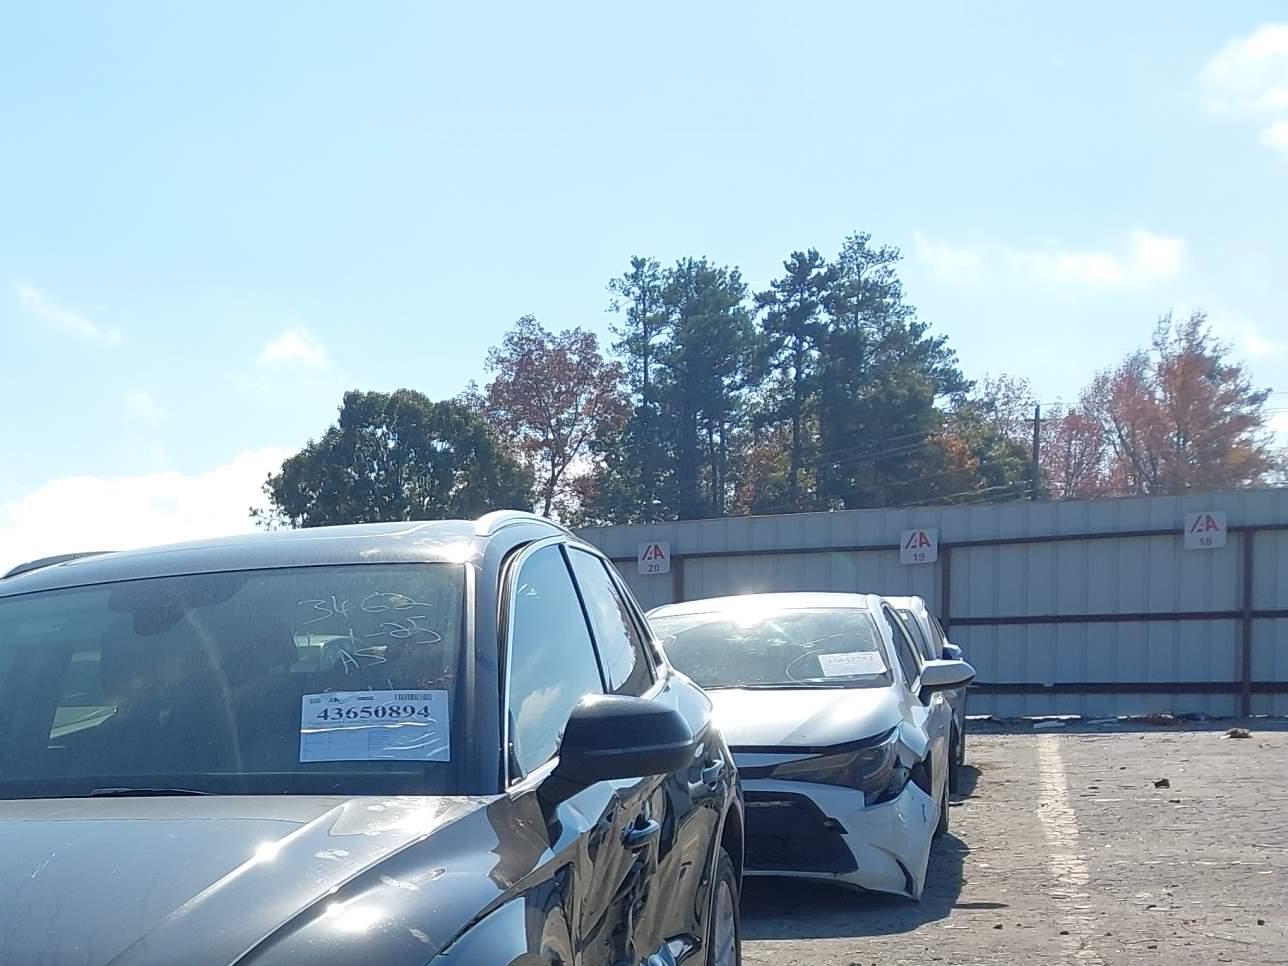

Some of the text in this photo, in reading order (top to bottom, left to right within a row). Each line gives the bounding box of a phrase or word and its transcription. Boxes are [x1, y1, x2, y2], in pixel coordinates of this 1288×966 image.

[912, 552, 926, 562] 19
[648, 564, 660, 573] 20
[316, 704, 431, 721] 43650894
